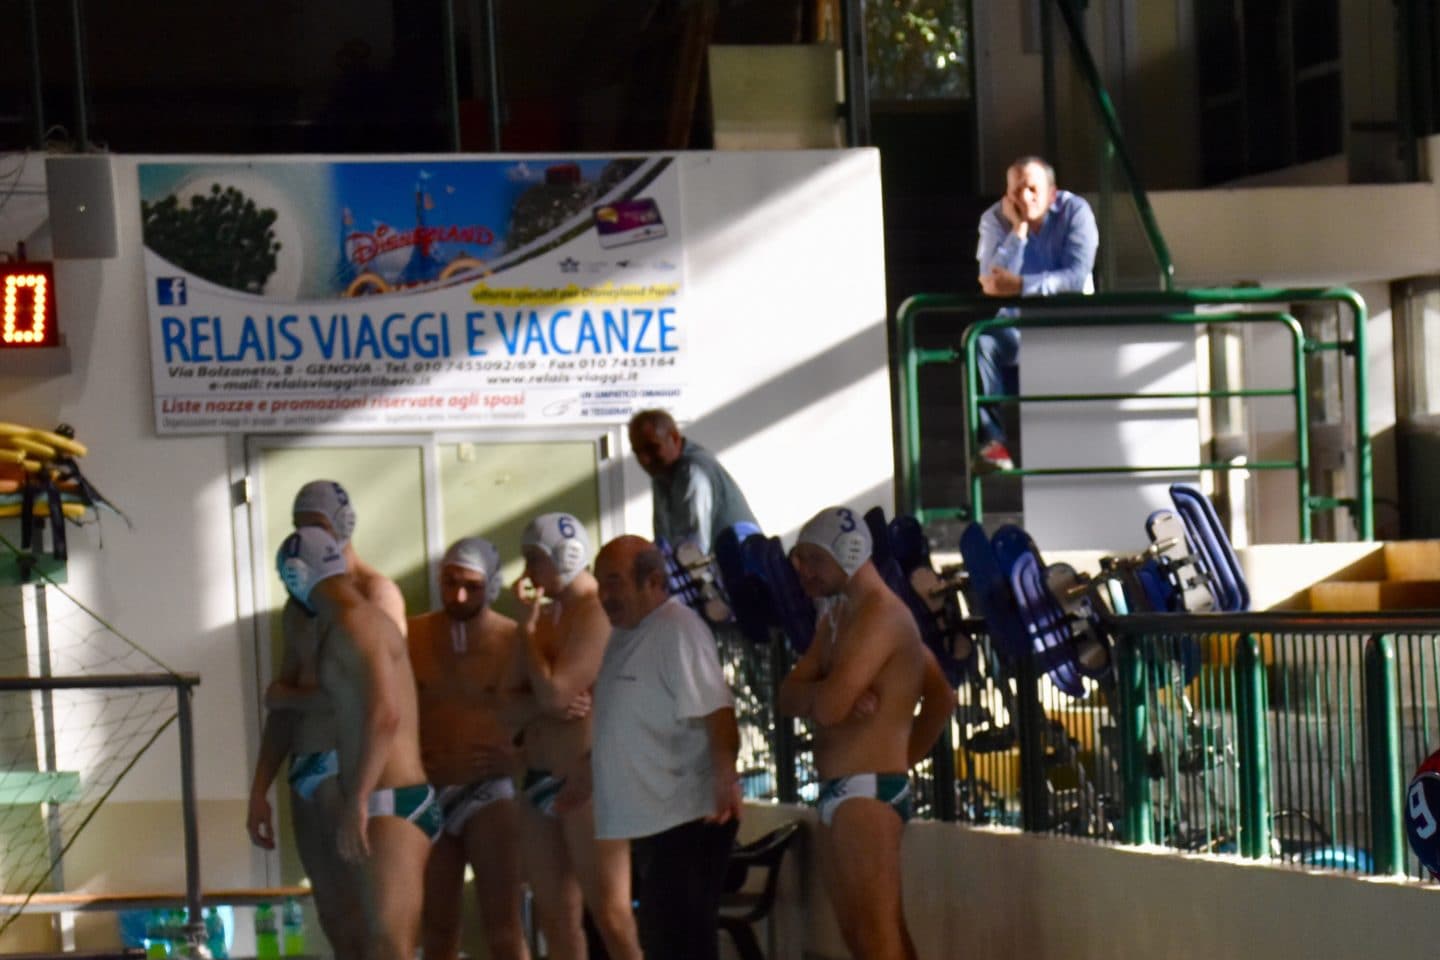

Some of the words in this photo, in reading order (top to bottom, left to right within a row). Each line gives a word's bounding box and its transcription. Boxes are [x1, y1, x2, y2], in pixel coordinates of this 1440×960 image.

[161, 315, 303, 363] RELAIS
[309, 312, 451, 360] VIAGGI
[466, 311, 488, 357] E
[493, 308, 680, 356] VACANZE
[168, 365, 194, 378] Via
[306, 363, 372, 376] GENOVA
[385, 362, 409, 374] Tel.
[413, 360, 442, 372] 010
[446, 359, 537, 371] 7455092/69
[549, 358, 575, 369] Fax
[579, 358, 607, 369] 010
[611, 356, 676, 368] 7455164
[160, 399, 203, 414] Liste
[206, 399, 256, 412] nozze
[257, 400, 267, 411] e
[271, 396, 368, 414] promozioni
[370, 395, 445, 410] riservate
[447, 391, 480, 413] agli
[482, 389, 525, 411] sposi
[557, 516, 576, 539] 6
[836, 508, 856, 533] 3
[1408, 780, 1438, 840] 9
